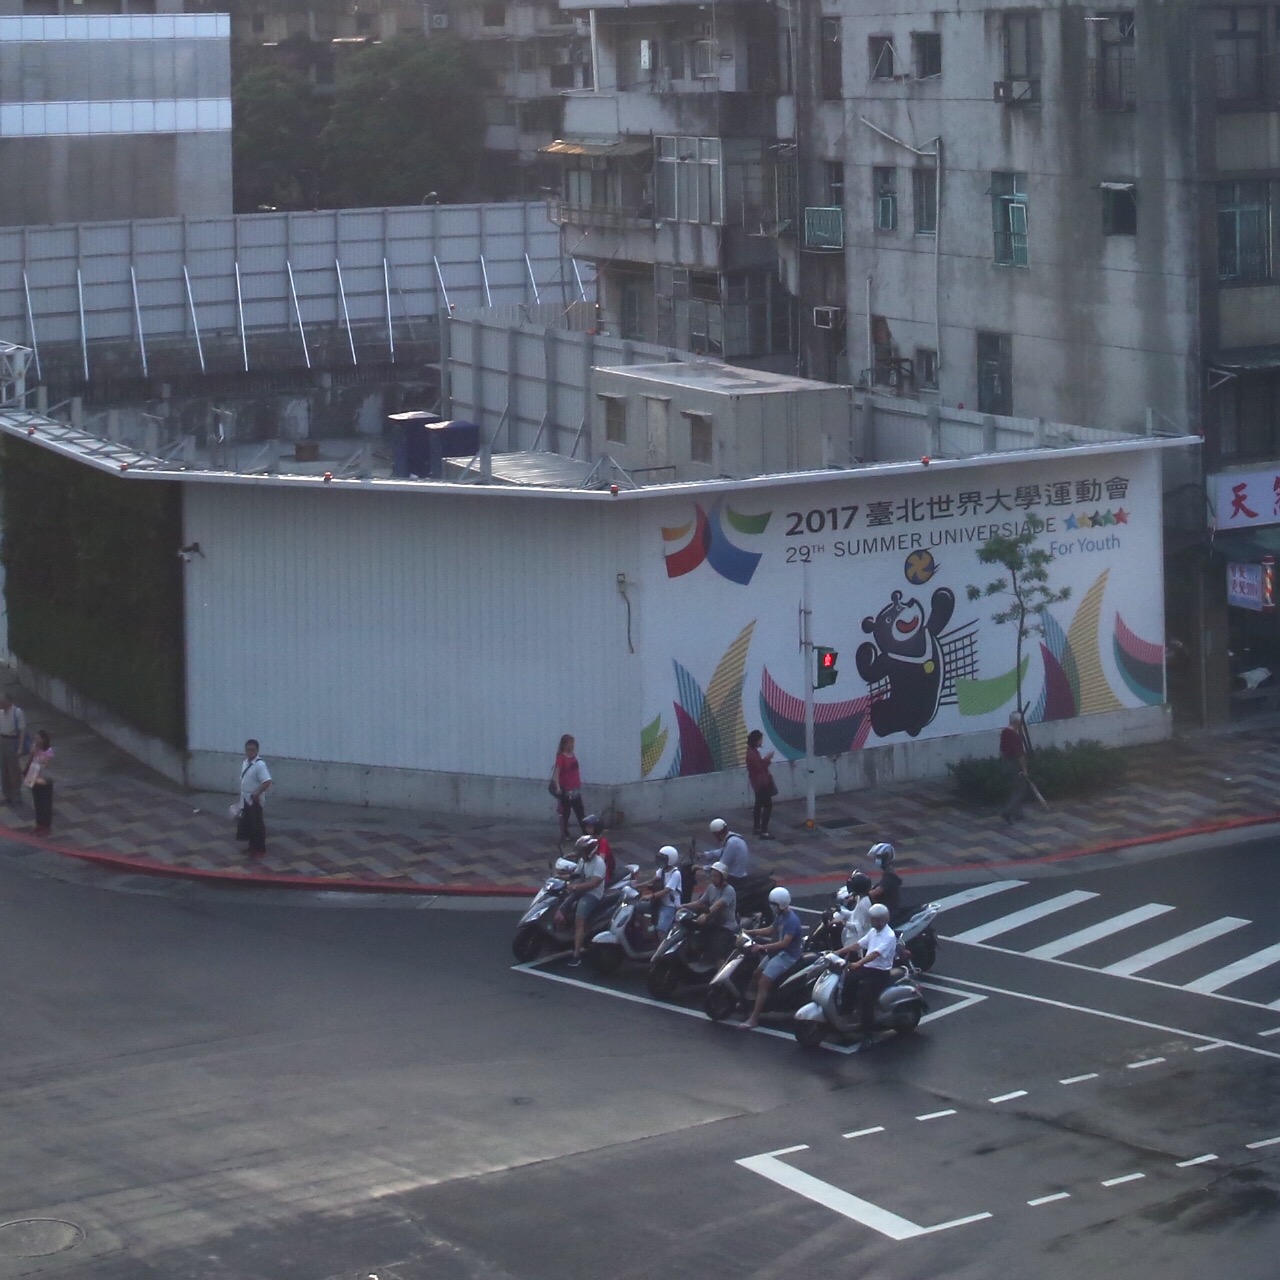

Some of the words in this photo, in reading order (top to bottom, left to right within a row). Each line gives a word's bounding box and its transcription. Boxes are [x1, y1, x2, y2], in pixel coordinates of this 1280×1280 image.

[785, 505, 860, 537] 2017
[865, 476, 1130, 529] 臺北世界大學運動會
[785, 544, 825, 564] 29TH
[834, 532, 922, 558] SUMMER
[930, 516, 1057, 547] UNIVERSIADE
[1050, 540, 1074, 557] For
[1077, 533, 1121, 554] Youth
